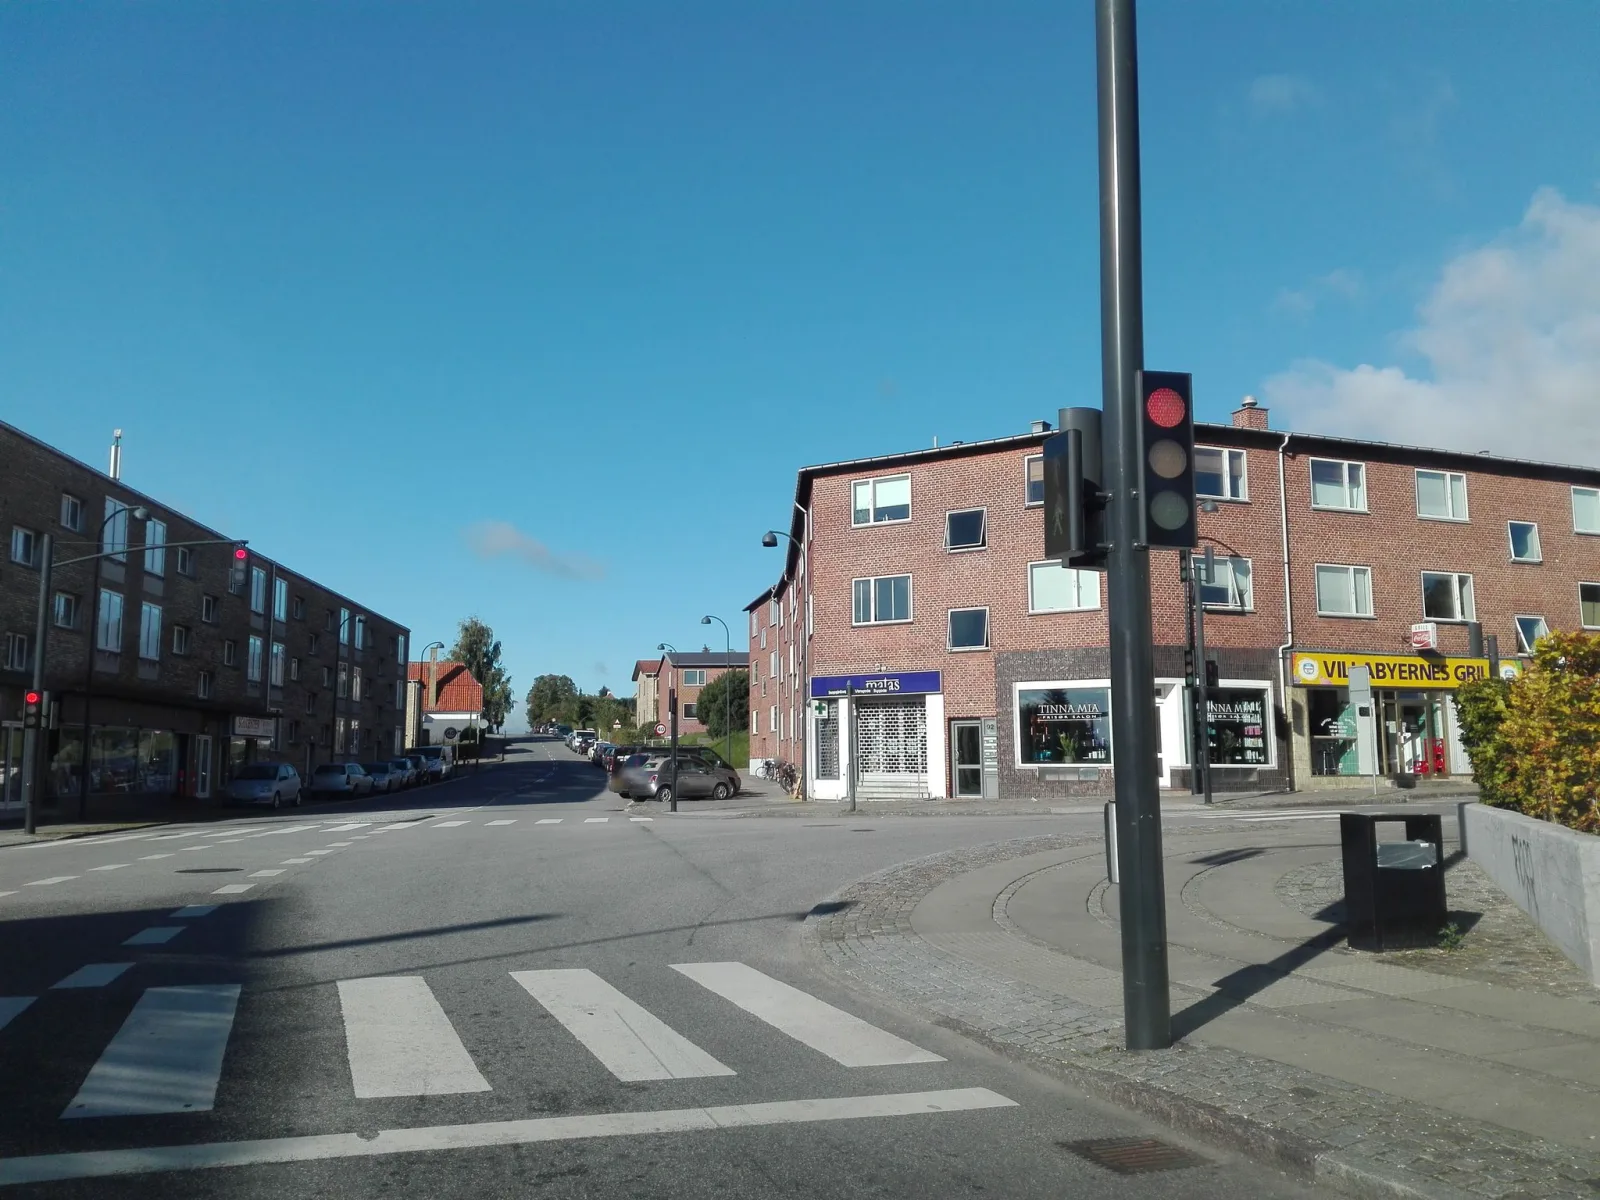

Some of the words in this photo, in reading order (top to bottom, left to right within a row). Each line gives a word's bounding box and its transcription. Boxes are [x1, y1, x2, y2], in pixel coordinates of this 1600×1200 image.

[1323, 660, 1450, 681] VILABYERNES
[865, 677, 900, 691] matas
[1038, 704, 1075, 714] TINNA
[1077, 703, 1100, 713] MIA
